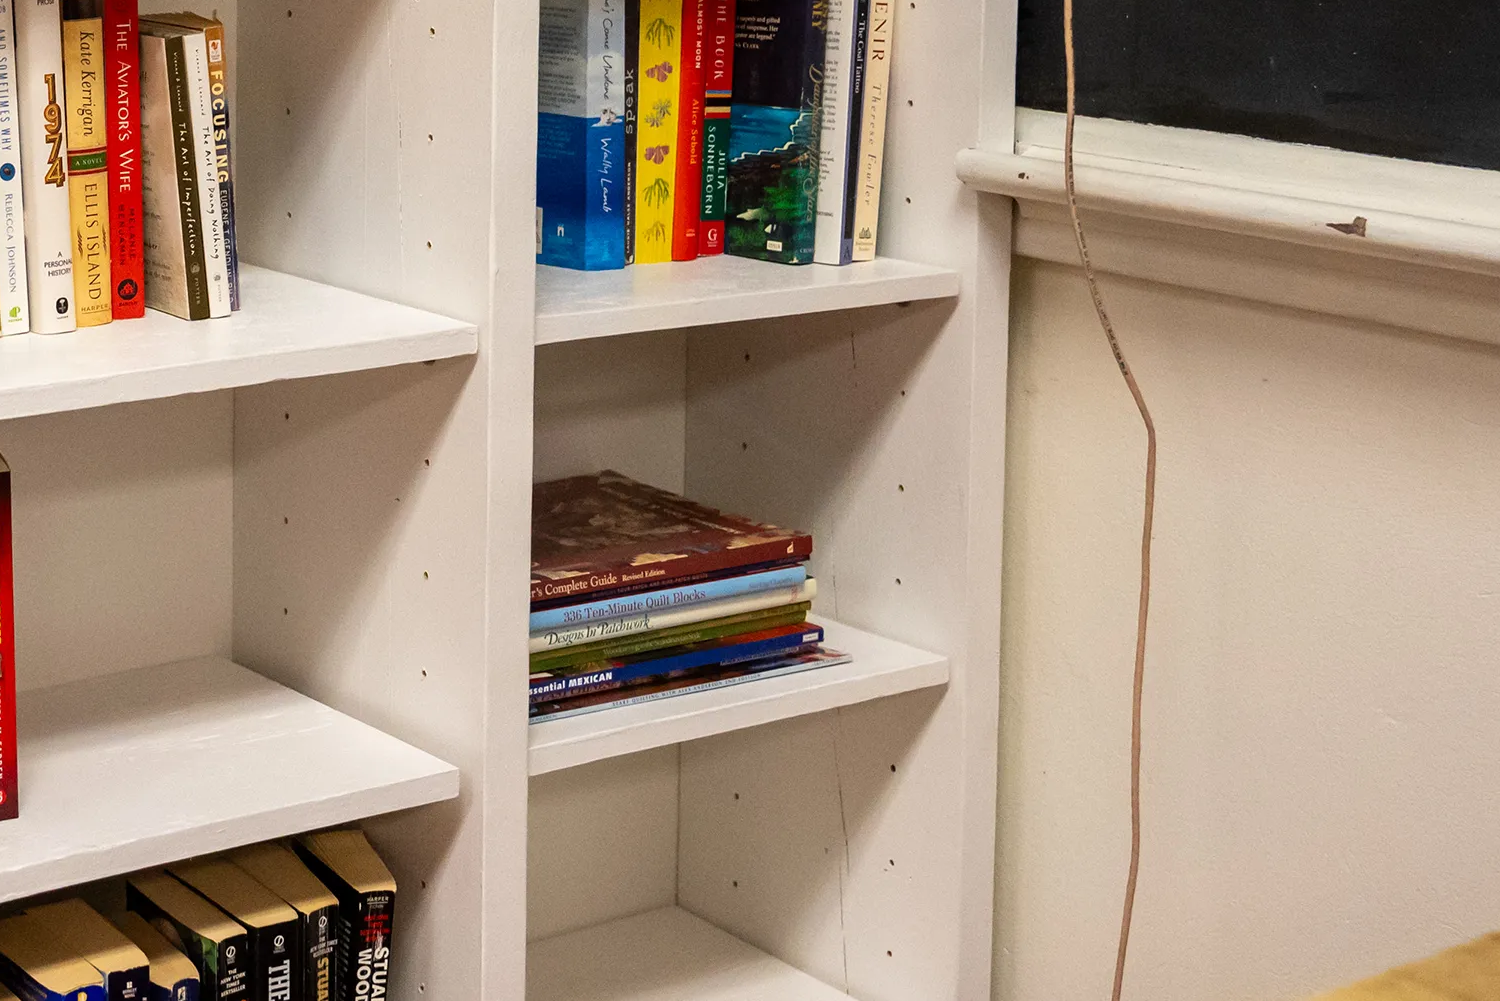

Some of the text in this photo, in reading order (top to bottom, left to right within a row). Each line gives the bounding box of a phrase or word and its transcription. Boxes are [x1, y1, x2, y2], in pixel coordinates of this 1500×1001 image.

[603, 18, 613, 50] Come
[856, 40, 865, 63] Coal
[603, 54, 614, 100] Undone
[713, 35, 725, 80] BOOK
[855, 65, 863, 94] Tattoo
[76, 31, 97, 137] Kate Kerrigan
[116, 19, 134, 193] THE AVIATOR'S WIFE
[626, 69, 635, 134] speak
[1, 128, 12, 151] WHY
[44, 73, 66, 188] 1974
[210, 70, 229, 183] FOCUSING
[689, 98, 700, 165] Alice Sebold
[864, 84, 883, 206] Therese Fowler
[205, 150, 213, 167] Art
[206, 173, 215, 182] of
[598, 137, 612, 213] Wally Lamb
[704, 124, 716, 214] SONNEBORN
[717, 149, 726, 189] JULIA
[206, 187, 215, 215] Doing
[4, 193, 17, 293] REBECCA JOHNSON
[84, 183, 102, 300] ELLIS ISLAND
[117, 204, 126, 266] BENJAMIN
[128, 208, 137, 261] MELANIE
[211, 219, 221, 260] Nothing
[48, 268, 72, 277] HISTORY
[81, 303, 109, 312] HARPER
[545, 581, 588, 596] Complete
[590, 573, 617, 588] Guide
[622, 572, 644, 581] Revised
[645, 569, 665, 578] Edition
[564, 590, 706, 622] 336 Ten-Minute Quilt Blocks
